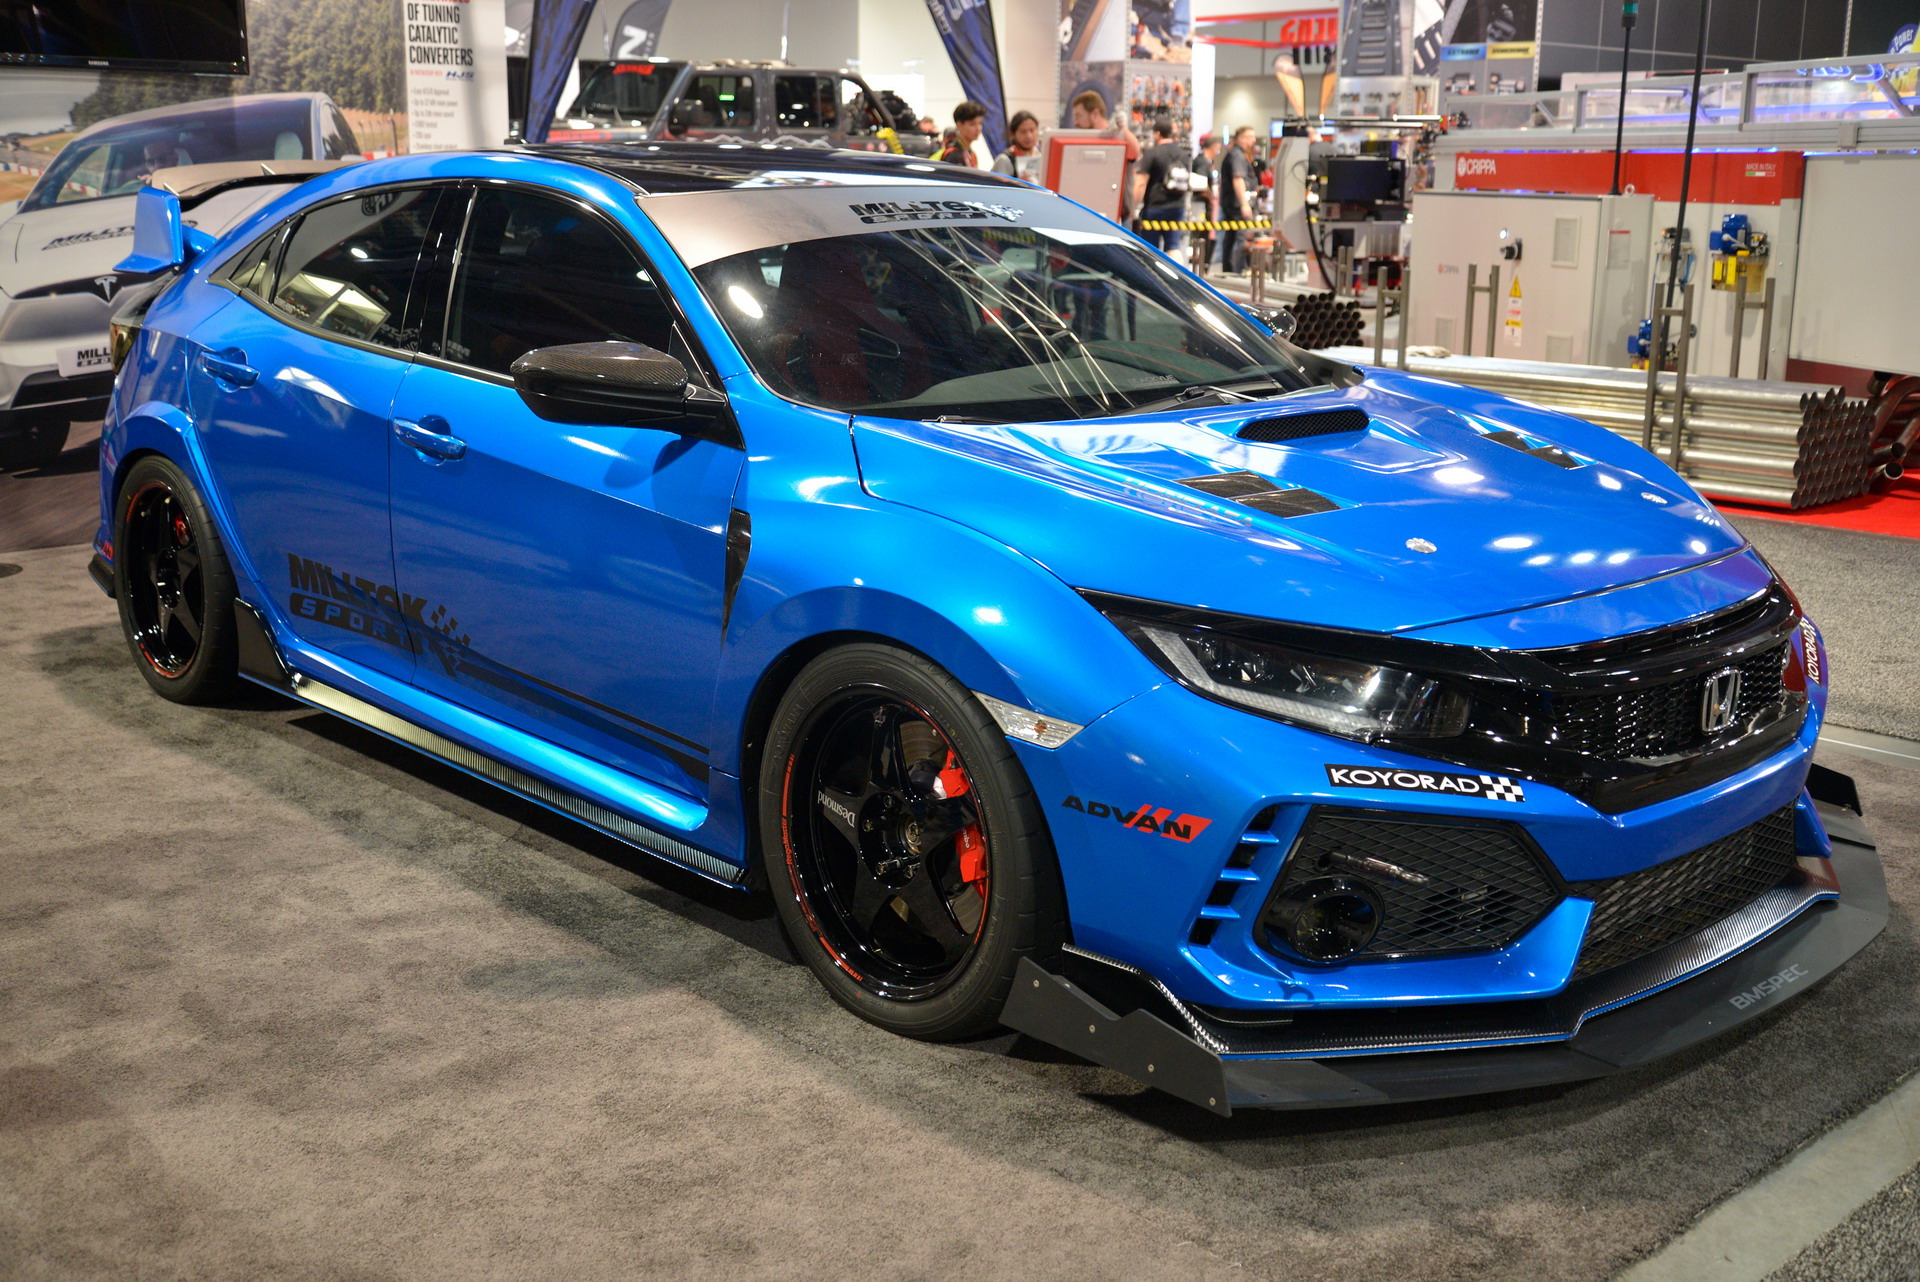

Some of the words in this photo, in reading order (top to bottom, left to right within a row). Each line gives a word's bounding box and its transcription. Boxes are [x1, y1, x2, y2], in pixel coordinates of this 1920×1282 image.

[407, 3, 419, 21] OF
[422, 4, 460, 23] TUNING
[408, 24, 458, 44] CATALYTIC
[1894, 28, 1914, 51] Power
[409, 45, 474, 66] CONVERTERS
[1467, 158, 1496, 175] CRIPPA
[77, 347, 111, 360] MILL
[1802, 628, 1820, 685] KOYORAD
[1330, 768, 1480, 794] KOYORAD
[817, 790, 857, 828] Desmond
[1061, 794, 1192, 840] ADVAN
[1728, 963, 1809, 1010] BMSPEC
